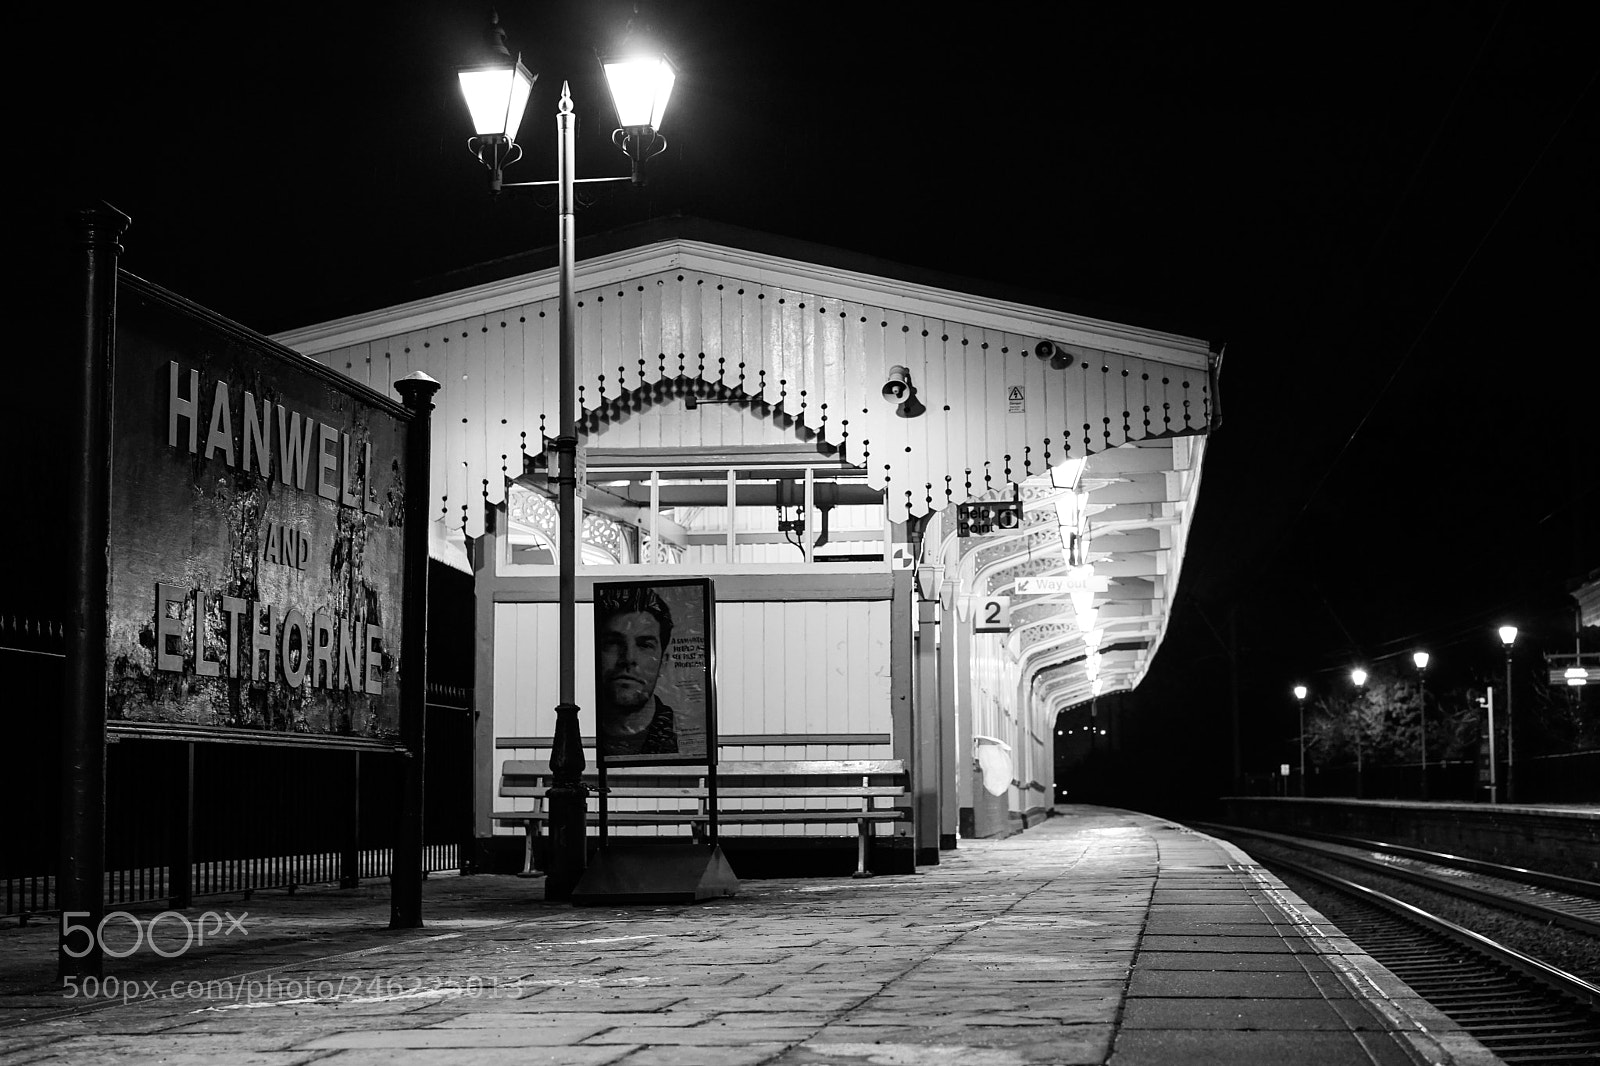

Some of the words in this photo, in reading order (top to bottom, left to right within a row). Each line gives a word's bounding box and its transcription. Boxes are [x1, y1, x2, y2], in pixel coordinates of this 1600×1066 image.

[168, 360, 380, 515] HANWELL
[959, 507, 990, 520] Help
[960, 522, 995, 534] Point
[263, 522, 312, 570] AND
[1036, 579, 1063, 591] Way
[1066, 579, 1087, 589] out
[984, 601, 1001, 624] 2
[155, 582, 383, 695] ELTHORNE
